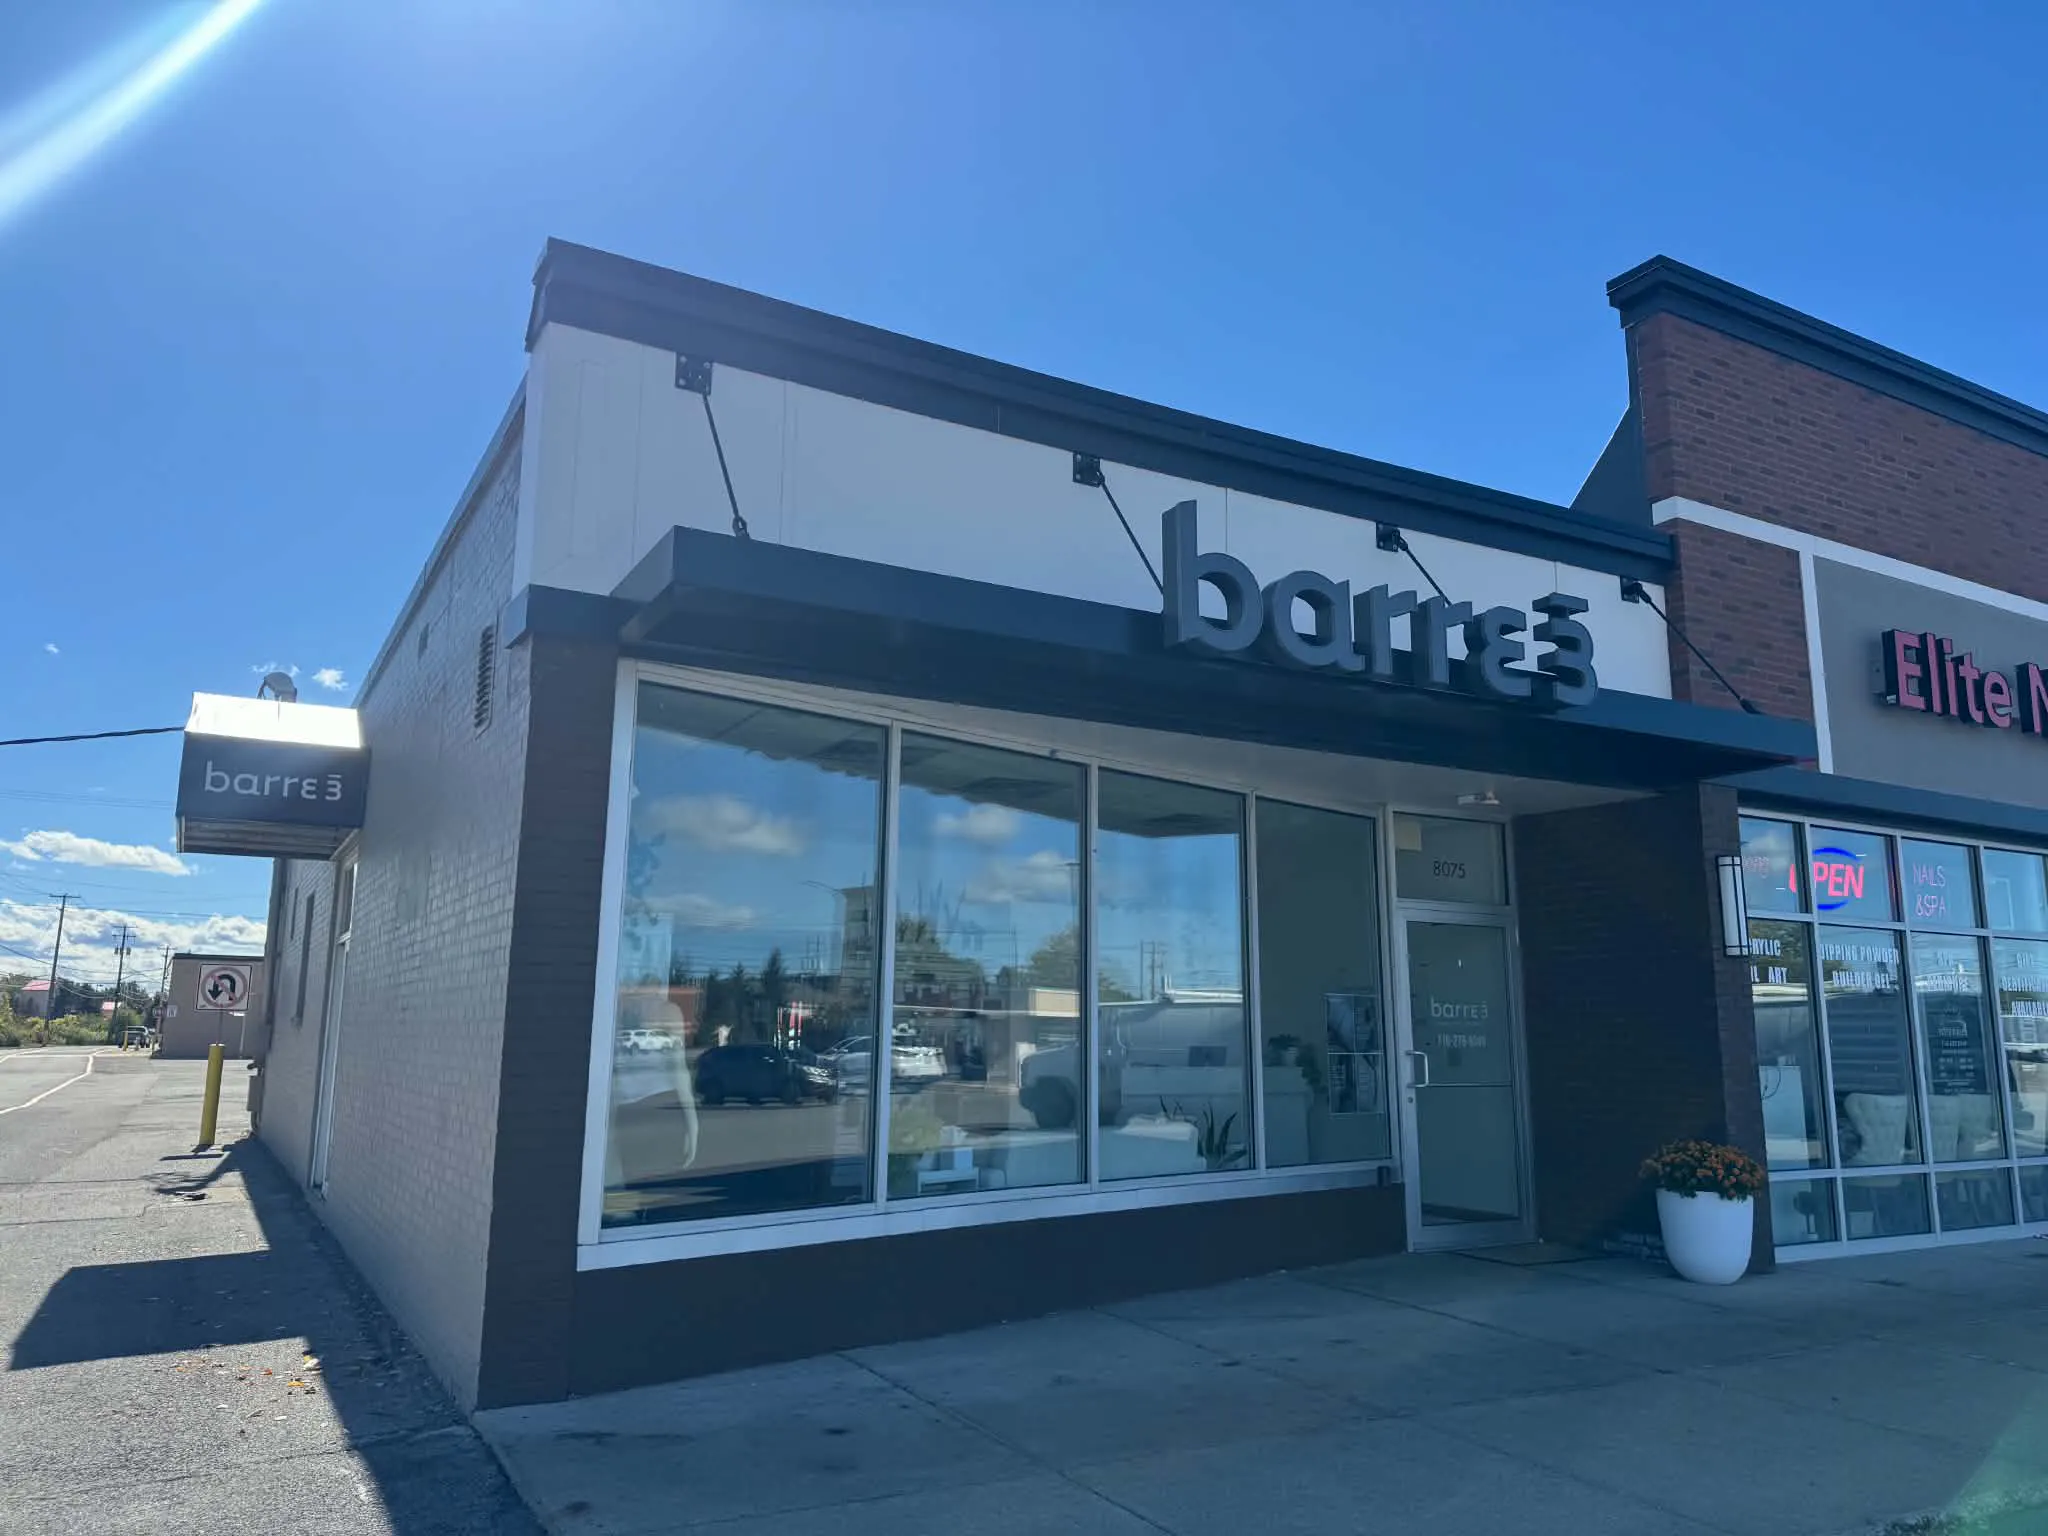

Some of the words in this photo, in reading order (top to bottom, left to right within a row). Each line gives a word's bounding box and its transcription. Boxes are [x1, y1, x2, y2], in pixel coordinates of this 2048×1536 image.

[1882, 629, 2013, 728] Elite
[1433, 860, 1466, 879] 8075
[1913, 862, 1946, 888] NAILS
[1750, 938, 1781, 957] RYLIC
[1860, 945, 1900, 965] POWDER
[1768, 966, 1788, 985] ART
